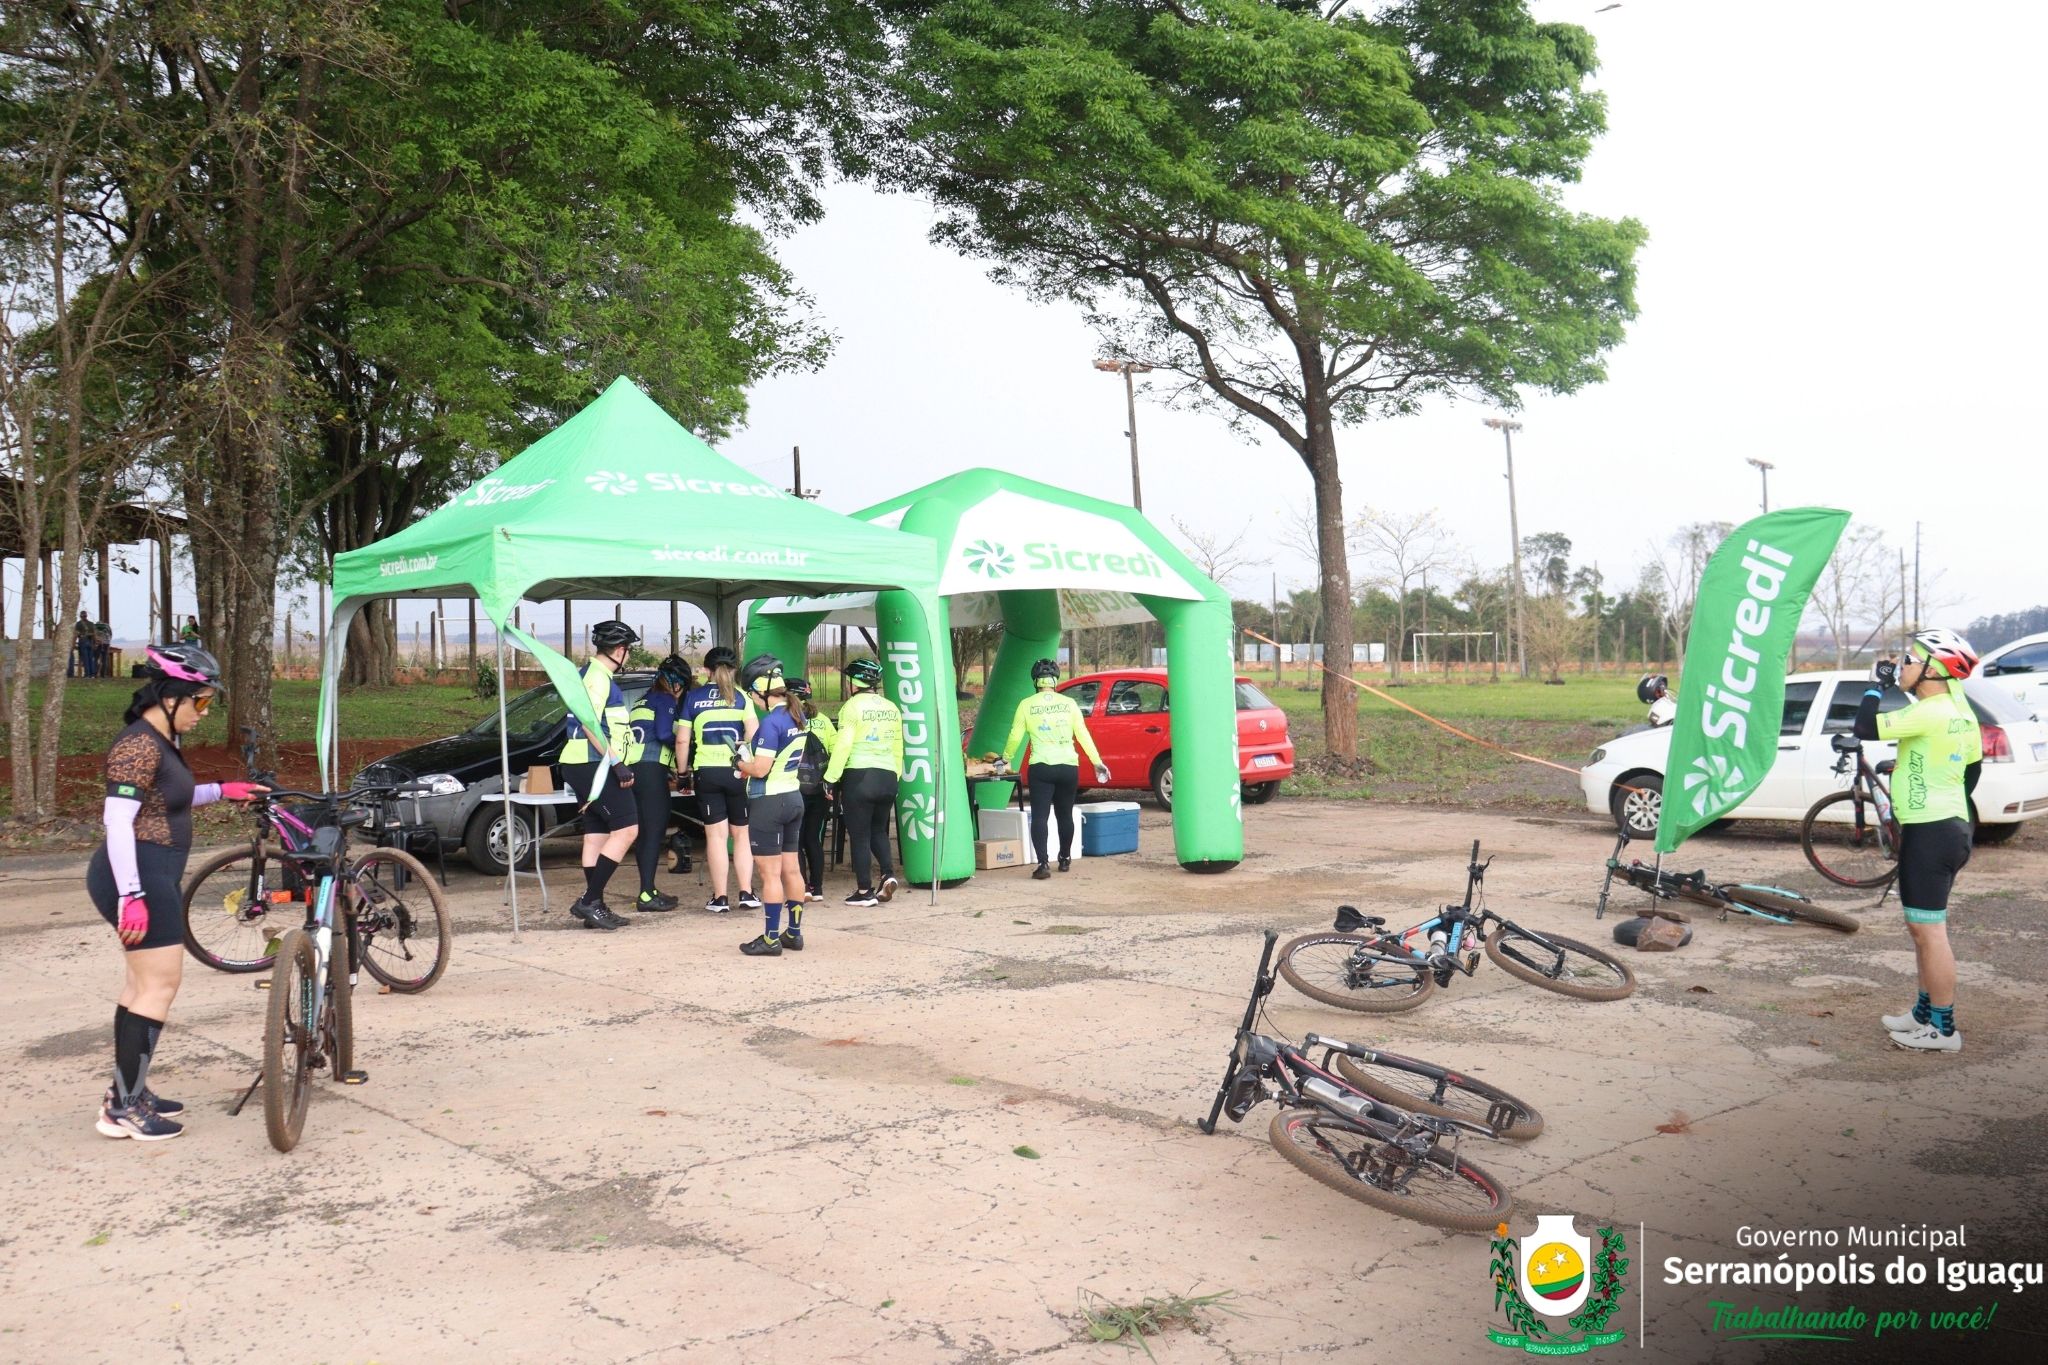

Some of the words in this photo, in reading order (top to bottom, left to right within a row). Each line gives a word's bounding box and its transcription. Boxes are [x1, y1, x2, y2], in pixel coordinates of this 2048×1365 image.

[463, 478, 558, 507] Sicredi
[645, 472, 789, 501] Sicredi
[379, 551, 439, 577] sicredi.com.br
[650, 544, 811, 567] sicredi.com.br
[1023, 543, 1163, 578] Sicredi
[1701, 538, 1794, 749] Sicredi
[886, 641, 932, 784] Sicredi
